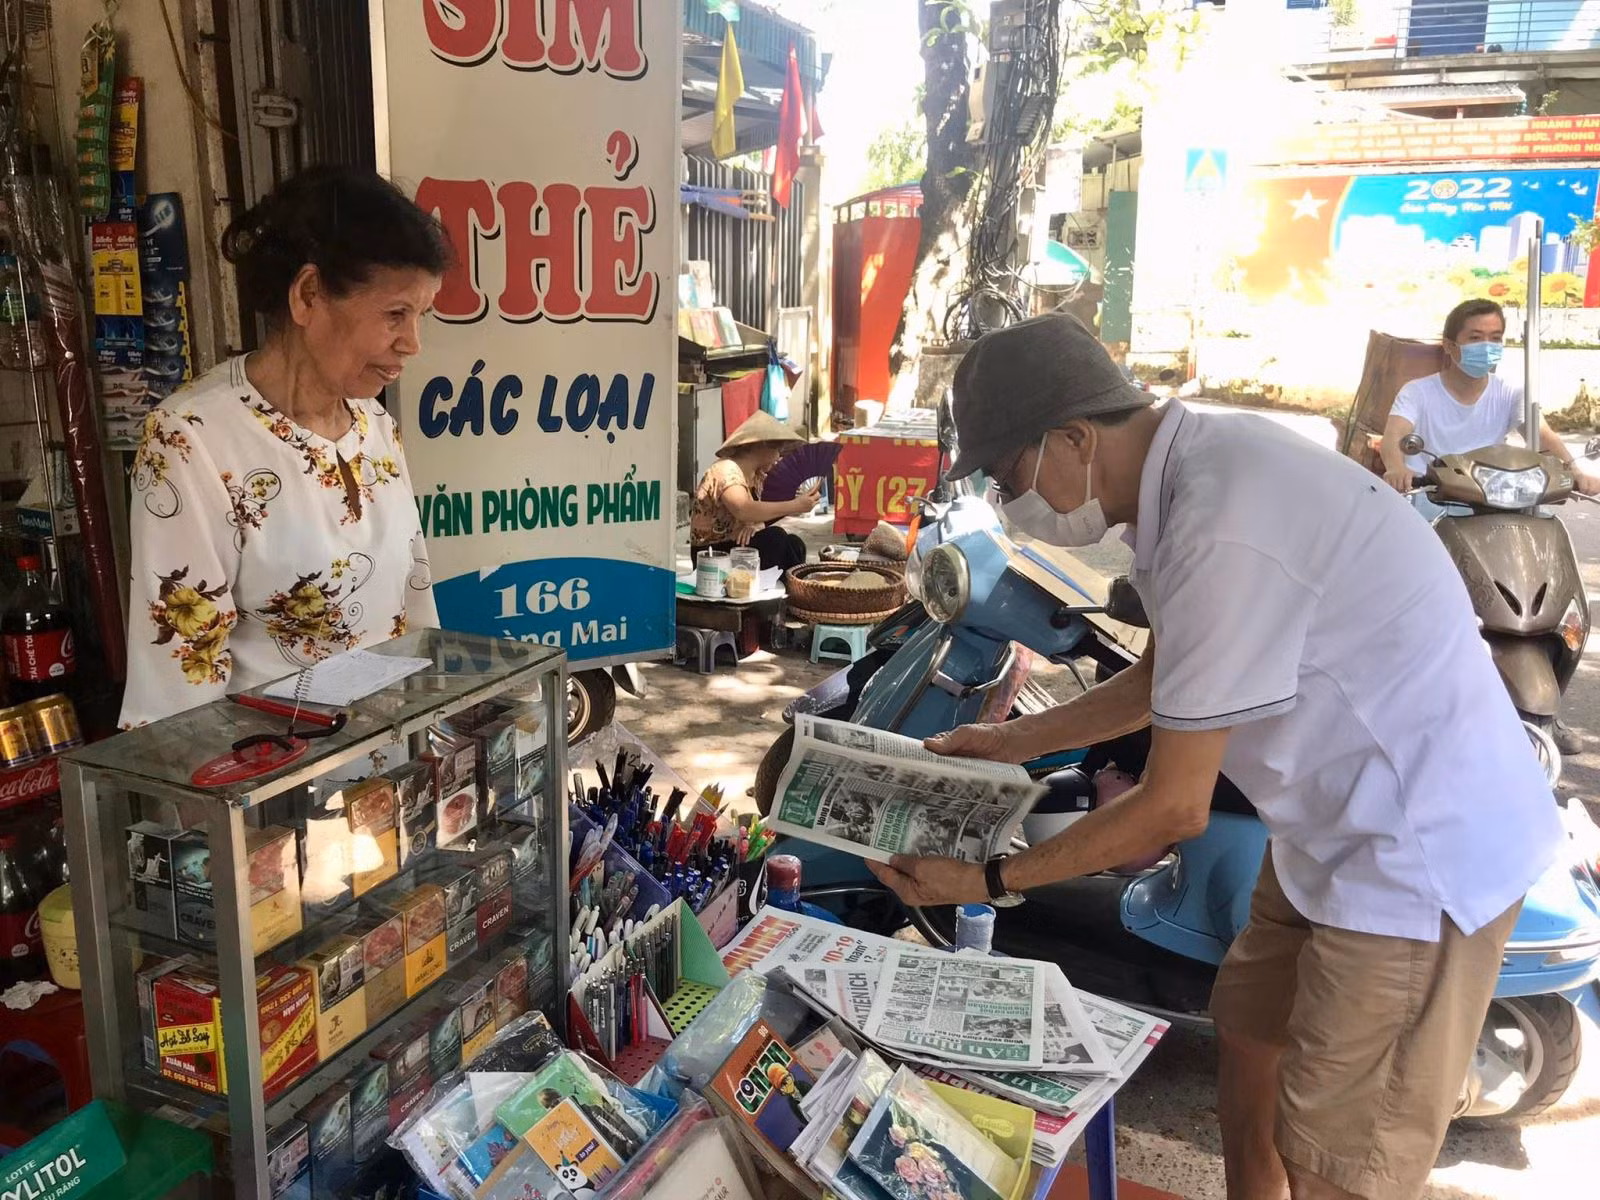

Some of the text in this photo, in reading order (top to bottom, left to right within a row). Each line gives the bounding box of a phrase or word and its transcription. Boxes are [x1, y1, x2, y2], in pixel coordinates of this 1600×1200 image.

[422, 0, 648, 80] SIM
[1403, 177, 1513, 200] 2022
[414, 130, 659, 324] THẺ
[418, 359, 655, 444] CÁC LOẠI
[414, 463, 661, 538] VĂN PHÒNG PHẨM
[494, 577, 591, 619] 166
[571, 616, 627, 646] Mai
[181, 911, 217, 931] CRAVE
[481, 905, 510, 930] CRAVEN
[449, 930, 477, 953] CRAVEN
[400, 1088, 425, 1114] CRAVEN
[5, 1158, 37, 1184] LOTTE
